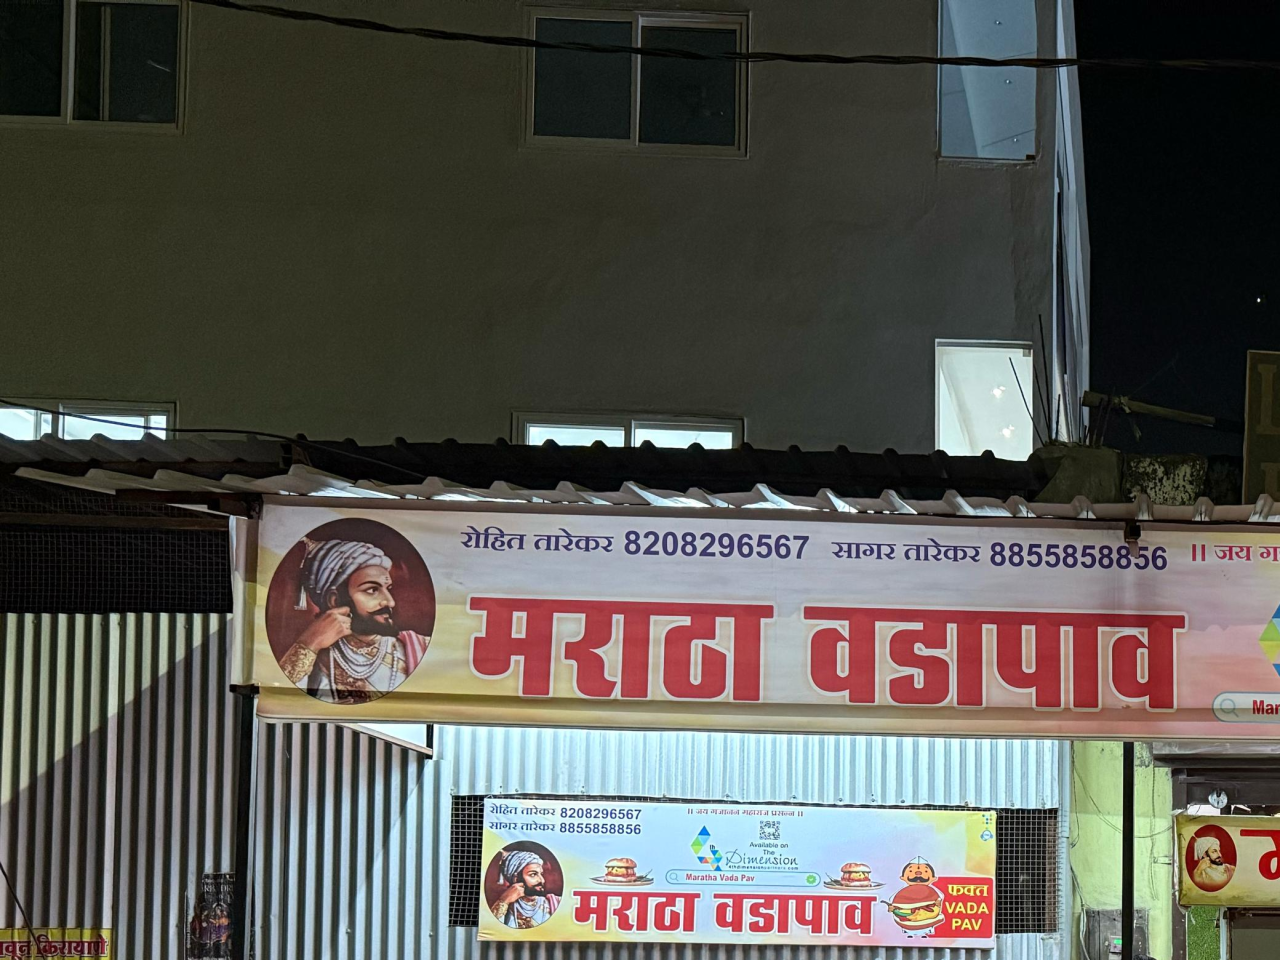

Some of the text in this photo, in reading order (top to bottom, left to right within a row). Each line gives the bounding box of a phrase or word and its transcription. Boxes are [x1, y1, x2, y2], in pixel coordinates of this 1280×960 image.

[460, 525, 525, 552] रोहित
[533, 527, 614, 554] तारेकर
[624, 531, 809, 560] 8208296567
[831, 540, 896, 561] सागर
[904, 538, 981, 563] तारेकर
[990, 541, 1168, 571] 8855858856
[1213, 544, 1252, 562] जय
[468, 595, 1186, 709] मराठा वडापाव
[489, 803, 642, 820] रोहित तारेकर 8208296567
[488, 820, 641, 835] सागर तारेकर 8855858856
[749, 841, 779, 849] Available
[725, 849, 798, 867] Dimension
[685, 873, 755, 882] Maratha Vada Pav
[947, 883, 988, 898] फक्त
[573, 888, 878, 936] मराठा वडापाव
[945, 901, 990, 915] VADA
[951, 918, 982, 932] PAV
